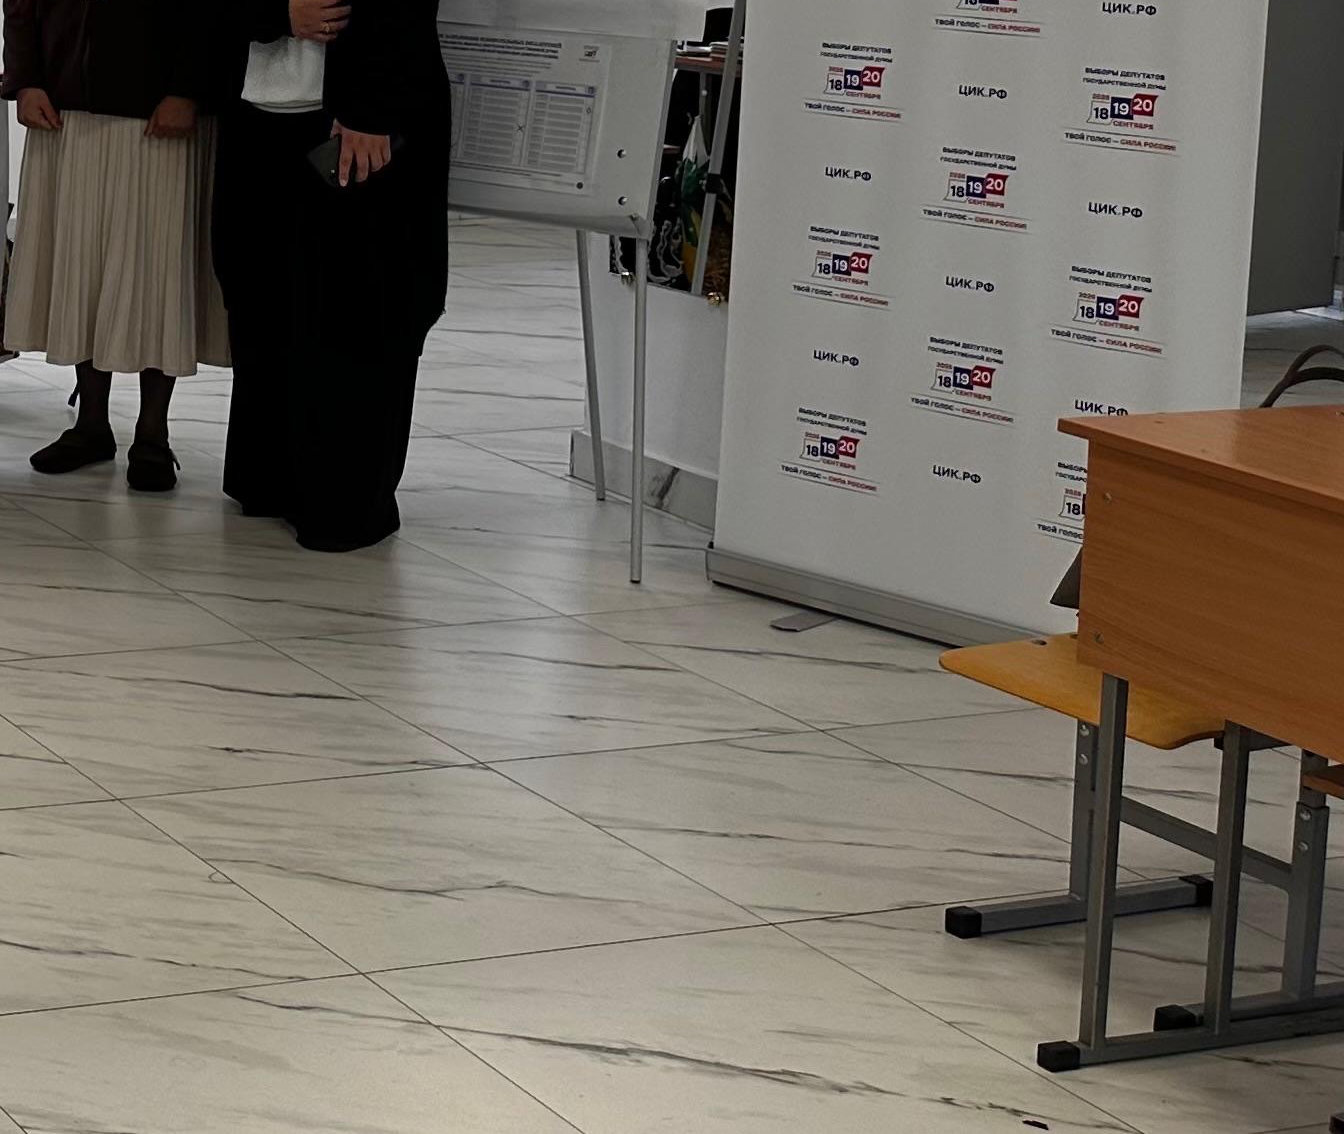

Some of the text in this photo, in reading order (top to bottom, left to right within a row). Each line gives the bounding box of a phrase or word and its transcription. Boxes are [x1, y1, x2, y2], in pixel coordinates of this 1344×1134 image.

[1102, 1, 1157, 16] ЦИК.РФ
[829, 71, 881, 91] 18 19 20
[958, 84, 1008, 99] ЦИК.РФ
[1093, 98, 1153, 120] 18 19 20
[825, 166, 872, 181] ЦИК.РФ
[950, 178, 1004, 198] 18 19 20
[1088, 201, 1143, 218] ЦИК.РФ
[817, 256, 868, 275] 18 19 20
[945, 275, 995, 293] ЦИК.РФ
[1079, 299, 1138, 319] 18 19 20
[813, 349, 859, 367] ЦИК.РФ
[937, 370, 991, 388] 18 19 20
[806, 441, 855, 457] 18 19 20
[933, 464, 982, 484] ЦИК.РФ
[1065, 502, 1081, 516] 18
